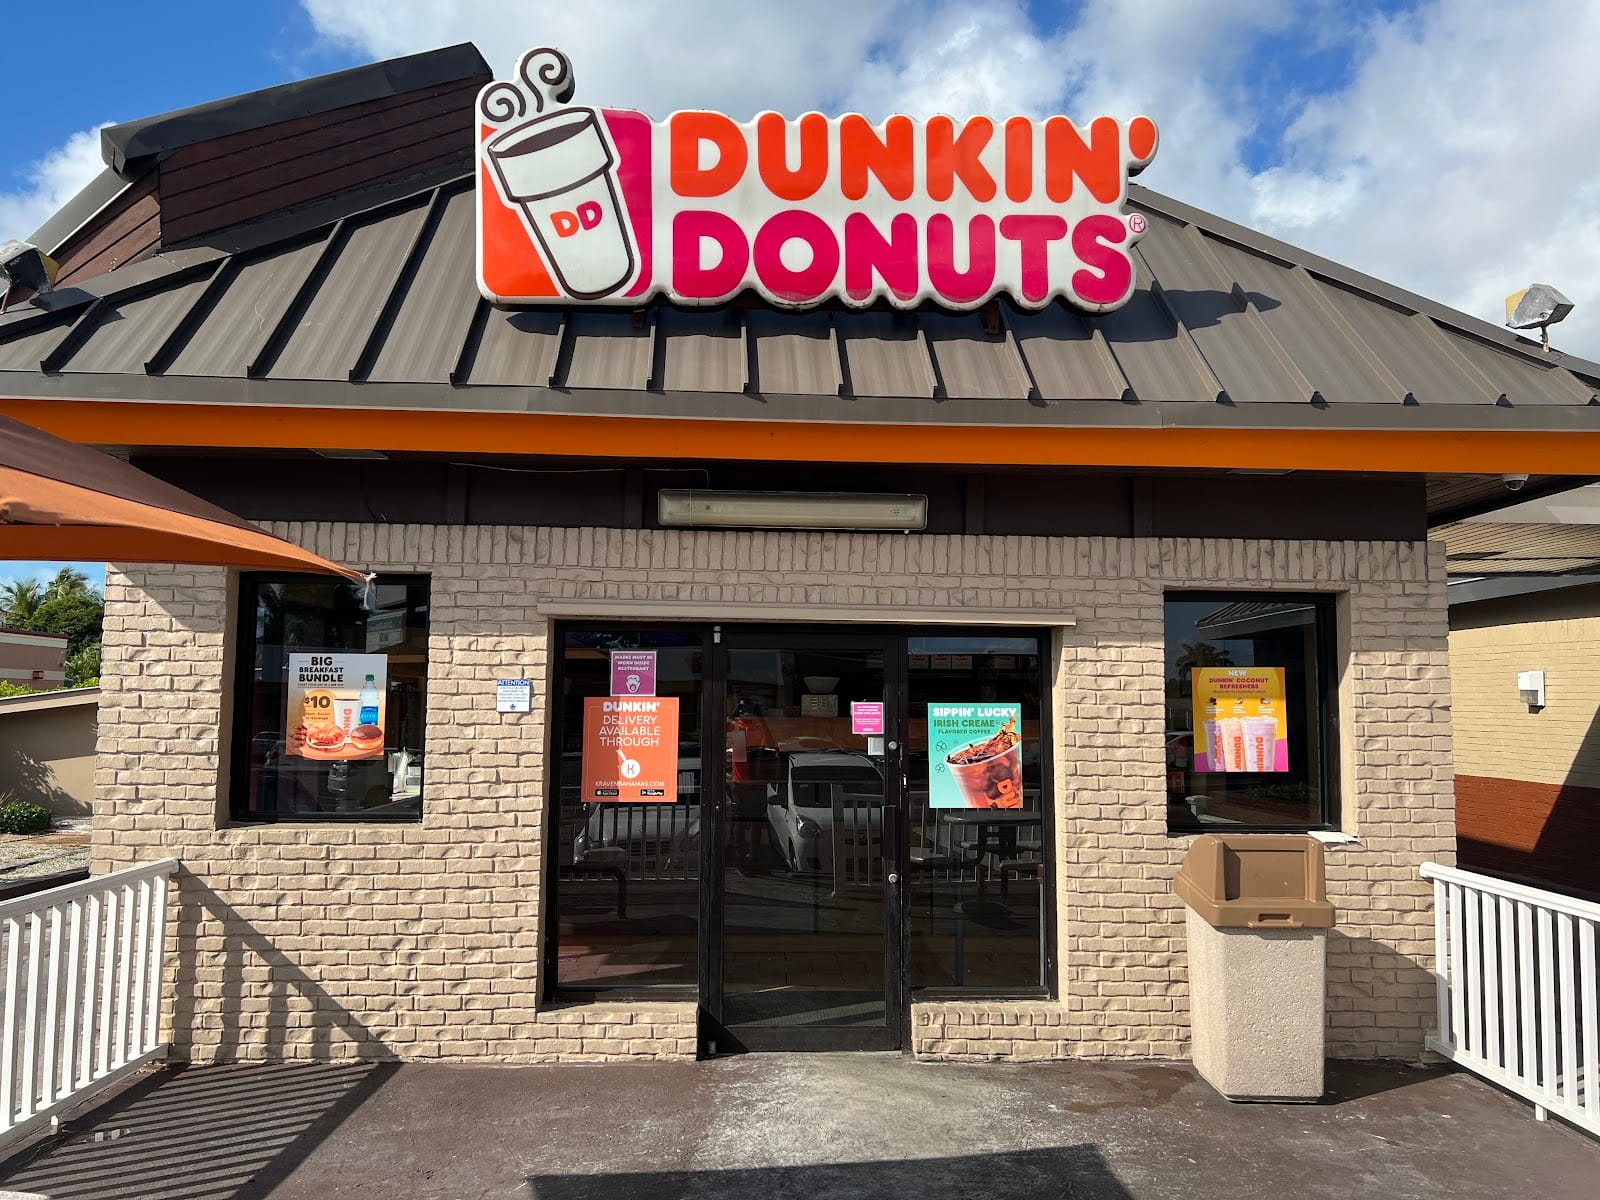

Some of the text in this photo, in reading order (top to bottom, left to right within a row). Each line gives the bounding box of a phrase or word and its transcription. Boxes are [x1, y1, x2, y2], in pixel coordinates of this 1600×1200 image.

[670, 112, 1158, 204] DUNKIN'
[550, 201, 603, 238] DD
[672, 209, 1131, 304] DONUTS
[311, 656, 333, 666] BIG
[299, 674, 344, 682] BUNDLE
[304, 696, 331, 708] $10
[603, 701, 660, 712] DUNKIN'
[933, 707, 1017, 717] SIPPIN' LUCKY
[603, 715, 657, 725] DELIVERY
[933, 719, 995, 727] IRISH CREME
[599, 726, 661, 736] AVAILABLE
[600, 736, 660, 747] THROUGH
